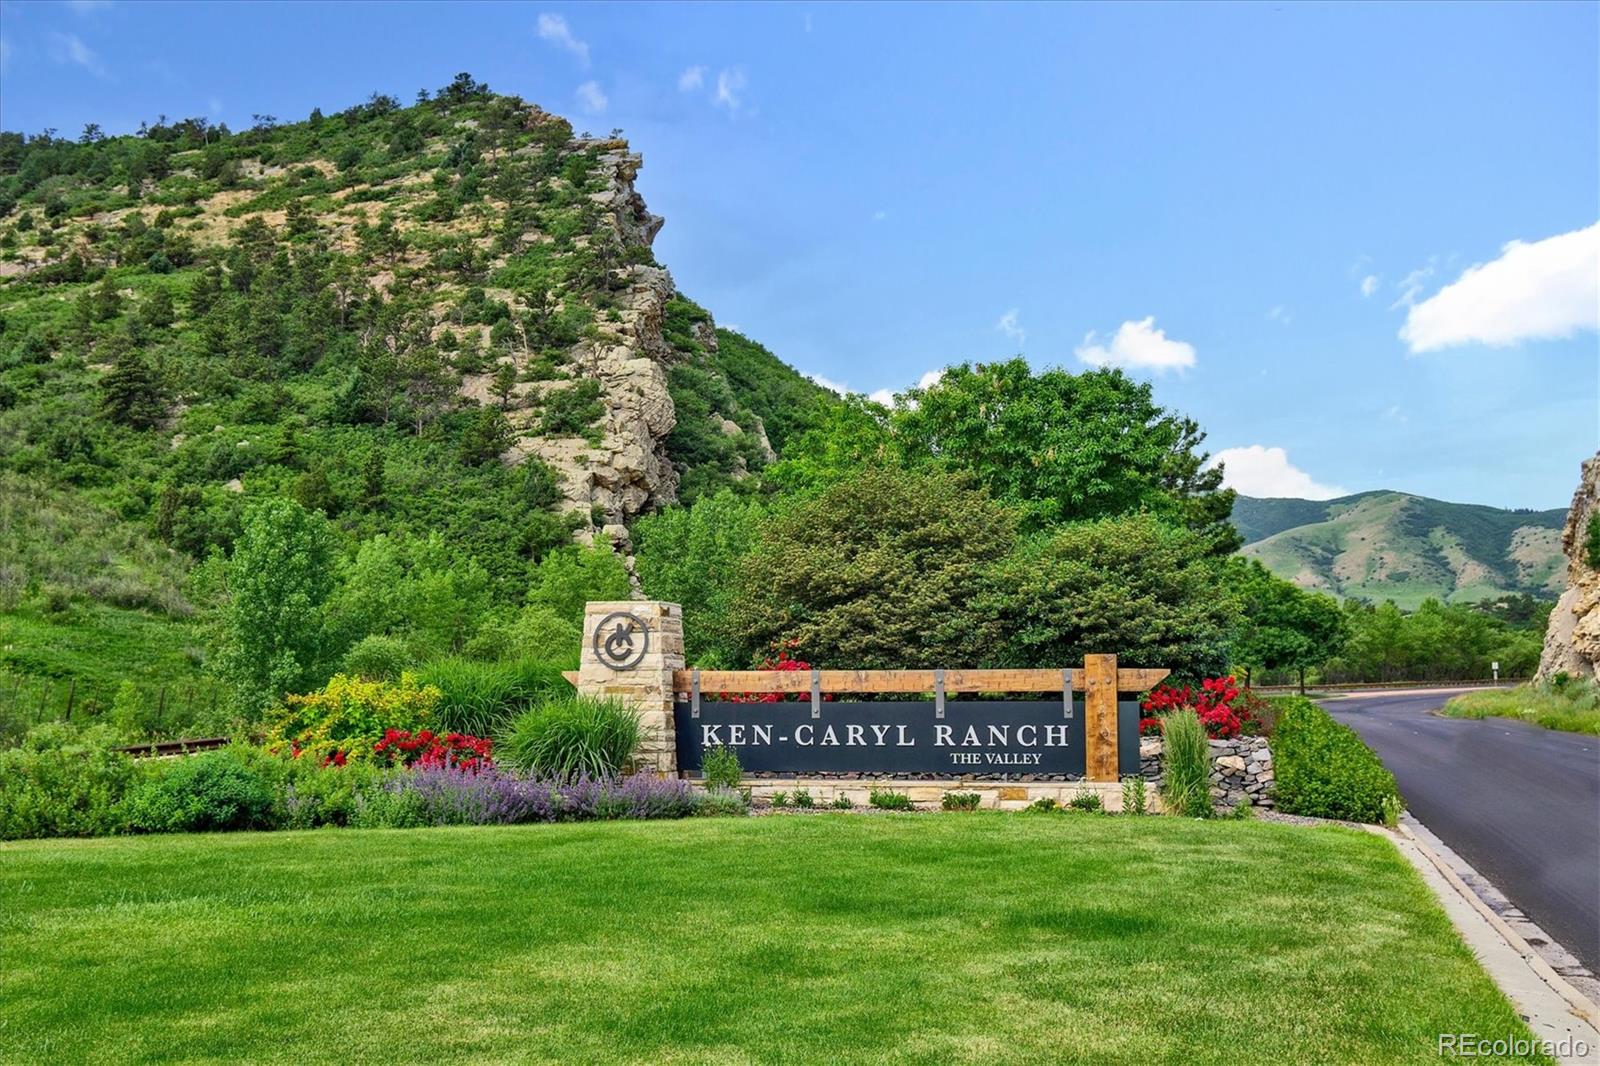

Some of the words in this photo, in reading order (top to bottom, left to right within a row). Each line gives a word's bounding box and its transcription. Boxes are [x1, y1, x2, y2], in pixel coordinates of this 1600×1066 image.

[701, 724, 915, 746] KEN-CARYL
[933, 724, 1069, 747] RANCH
[950, 753, 981, 765] THE
[985, 753, 1042, 765] VALLEY
